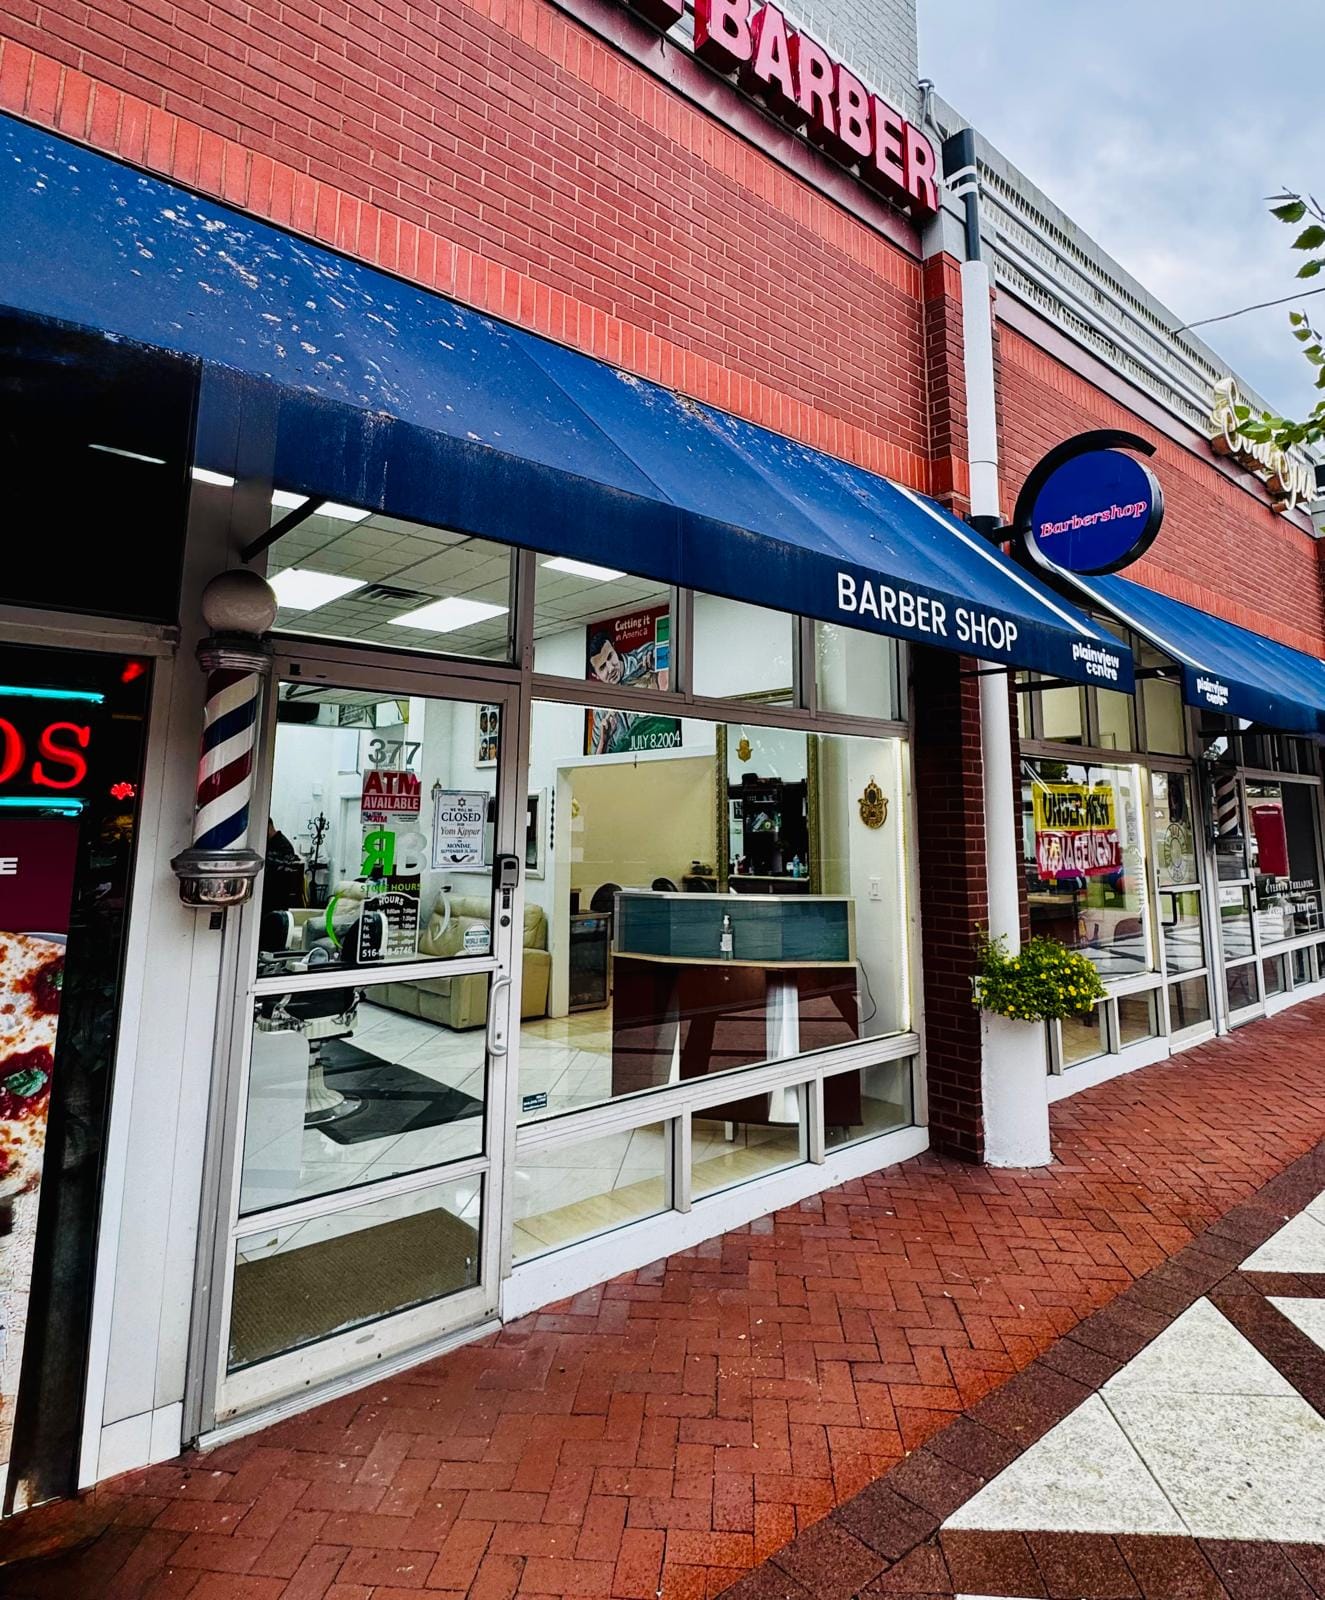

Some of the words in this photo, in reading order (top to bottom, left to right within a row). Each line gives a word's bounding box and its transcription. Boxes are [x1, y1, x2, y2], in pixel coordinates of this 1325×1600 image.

[706, 0, 938, 212] BARBER
[1040, 500, 1148, 538] Barbershop
[615, 617, 642, 632] Cutting
[643, 615, 651, 626] it
[837, 572, 948, 637] BARBER
[955, 607, 1018, 652] SHOP
[622, 628, 648, 641] America
[1072, 643, 1119, 668] plainview
[1086, 660, 1118, 681] centre
[368, 738, 422, 765] 377
[628, 734, 649, 751] JULY
[364, 771, 422, 796] ATM
[363, 796, 419, 810] AVAILABLE
[1043, 792, 1085, 827] UNDER
[1086, 793, 1110, 826] NEW
[441, 812, 481, 822] CLOSED
[379, 896, 404, 905] HOURS
